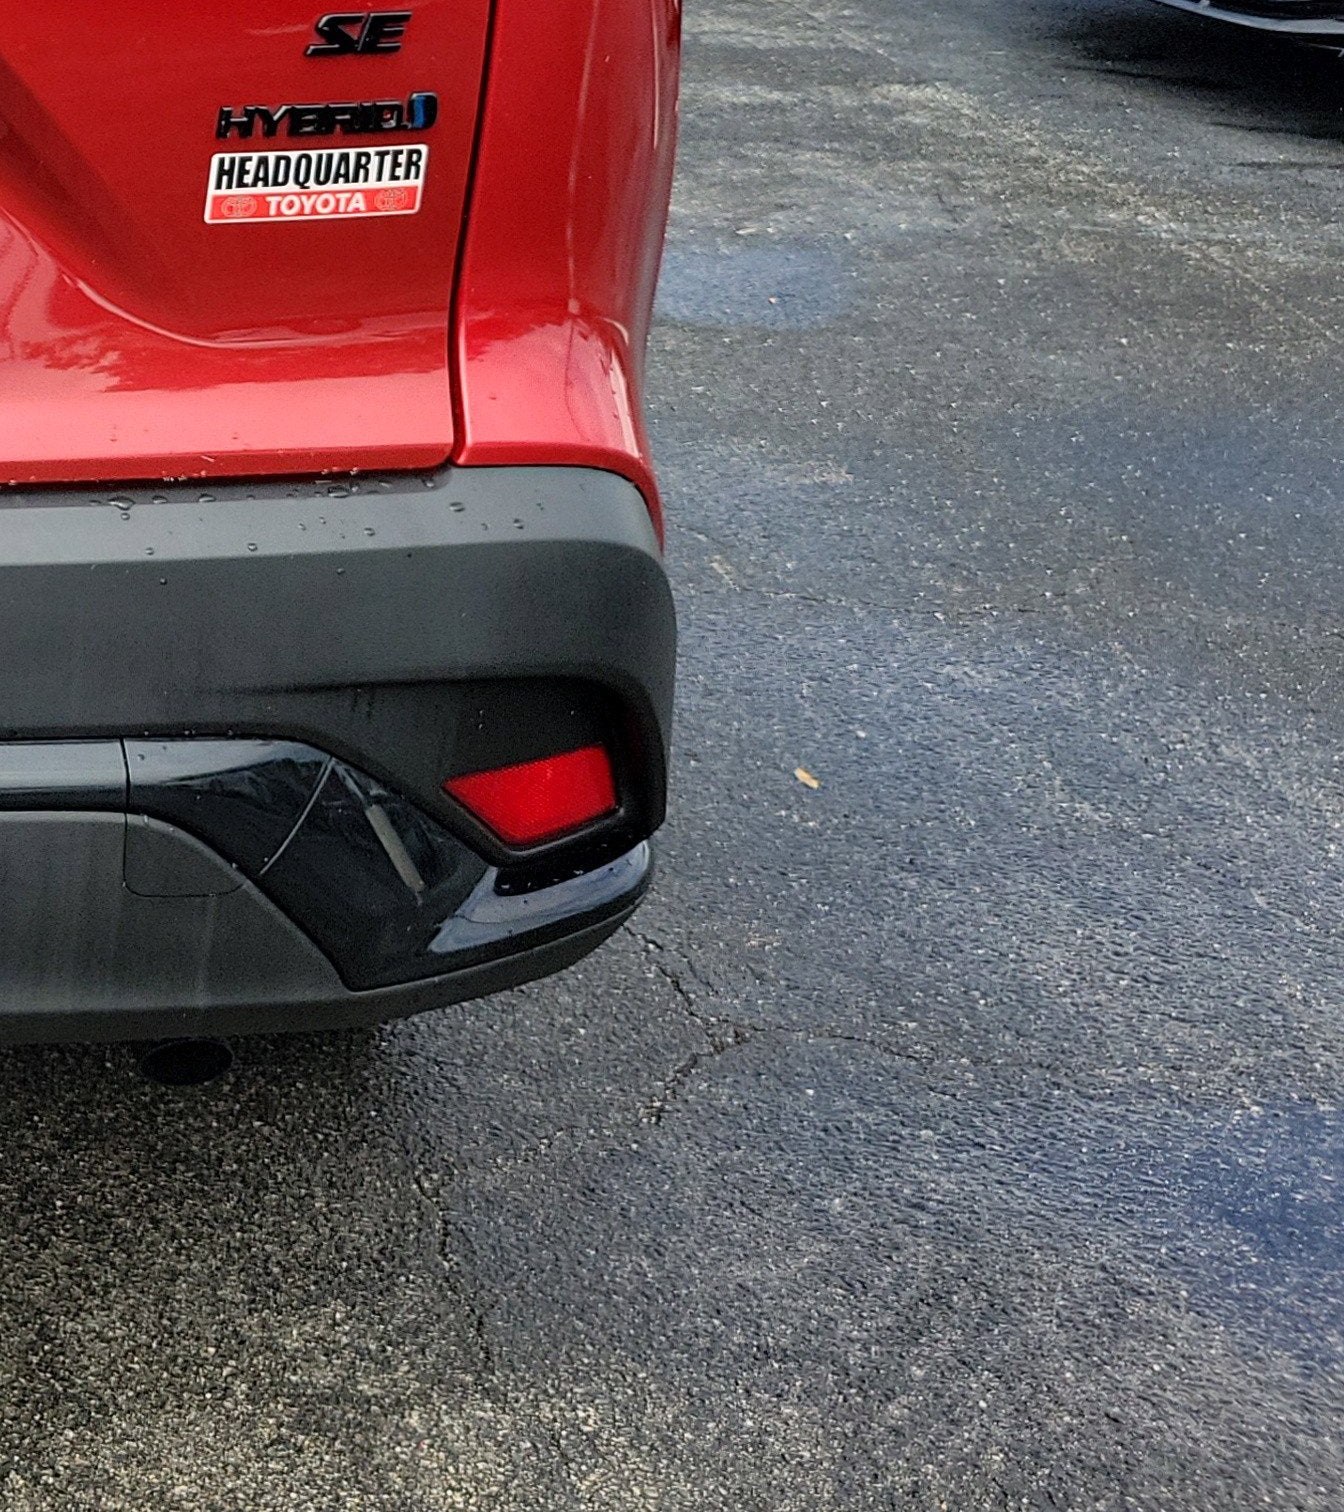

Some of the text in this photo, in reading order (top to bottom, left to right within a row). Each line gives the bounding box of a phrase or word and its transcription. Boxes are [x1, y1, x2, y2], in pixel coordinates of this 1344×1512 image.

[304, 10, 413, 58] SE
[216, 99, 405, 139] HYBRID
[214, 148, 423, 190] HEADQUARTER
[265, 192, 368, 216] TOYOTA
